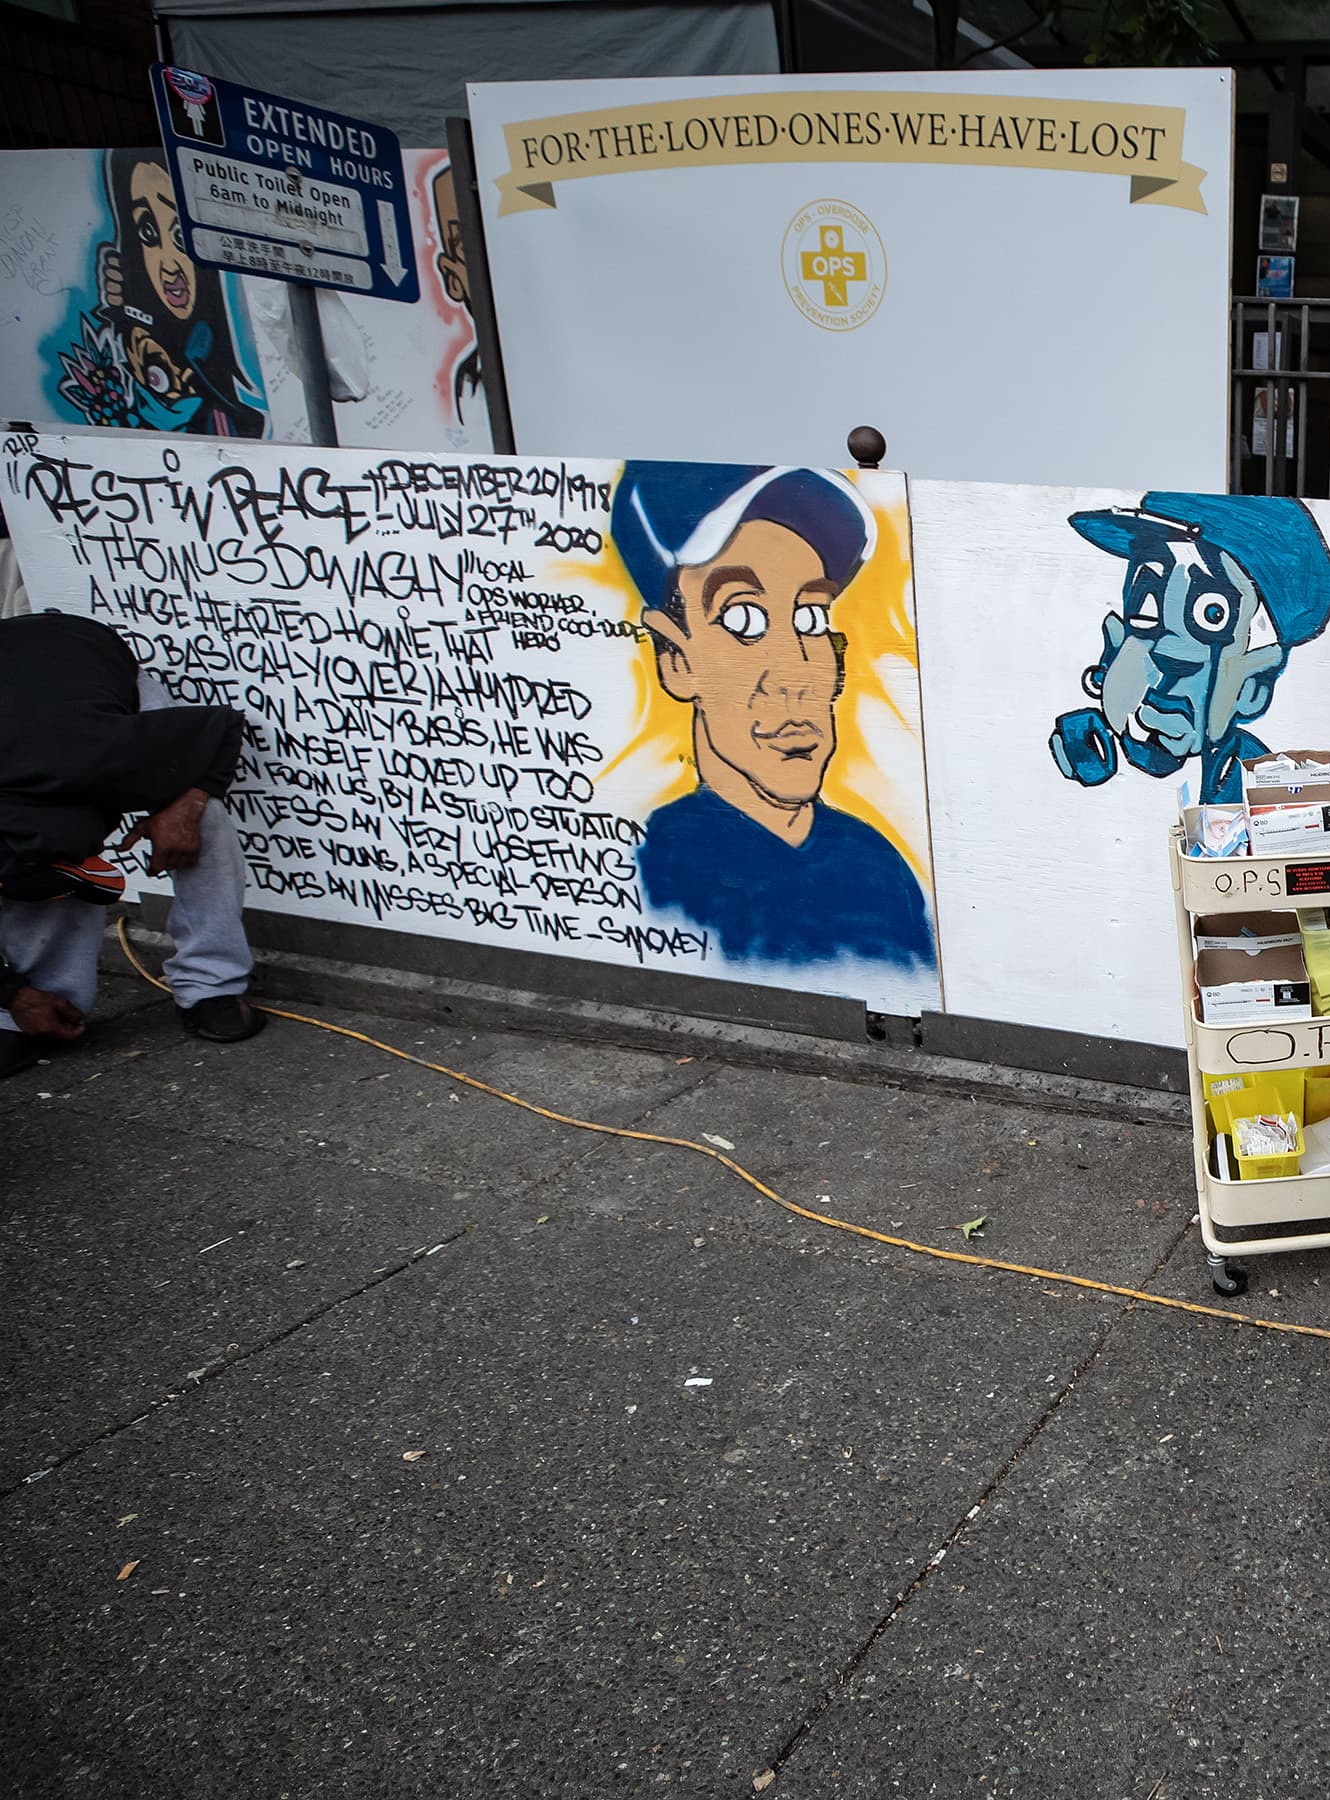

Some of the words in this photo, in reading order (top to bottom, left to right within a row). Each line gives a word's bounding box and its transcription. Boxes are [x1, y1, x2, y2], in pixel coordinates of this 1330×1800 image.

[243, 96, 378, 160] EXTENDED
[521, 134, 586, 169] FOR
[589, 126, 661, 160] THE
[664, 114, 779, 152] LOVED
[788, 110, 883, 148] ONES
[890, 111, 950, 147] WE
[959, 113, 1058, 155] HAVE
[1067, 121, 1166, 163] LOST
[193, 157, 250, 186] Public
[254, 172, 303, 198] Toilet
[310, 187, 351, 210] Open
[246, 134, 312, 169] OPEN
[330, 155, 395, 190] HOURS
[210, 184, 247, 206] 6am
[253, 192, 270, 210] to
[276, 200, 345, 228] Midnight
[811, 255, 855, 278] OPS
[397, 497, 463, 540] JULY
[477, 556, 535, 583] LOCAL
[90, 575, 114, 615] A
[113, 584, 190, 629] HUGE
[194, 589, 332, 644] HEARTED
[427, 620, 500, 666] THAT
[433, 666, 464, 708] A
[456, 665, 592, 721] HUNDRED
[245, 684, 287, 730] ON
[293, 685, 316, 722] A
[312, 697, 395, 743] DAILY
[493, 719, 529, 758] HE
[534, 725, 604, 767] WAS
[263, 760, 337, 797] FROM
[377, 777, 414, 817] BY
[420, 787, 442, 815] A
[439, 791, 530, 832] STUPID
[479, 762, 520, 802] UP
[519, 767, 594, 804] TOO
[351, 807, 382, 841] AN
[388, 814, 462, 863] VERY
[269, 833, 317, 860] DIE
[407, 850, 425, 874] A
[423, 853, 530, 897] SPECIAL
[530, 871, 643, 915] PERSON
[326, 870, 358, 907] AN
[360, 879, 464, 921] MISSES
[463, 896, 518, 930] BIG
[512, 904, 581, 942] TIME
